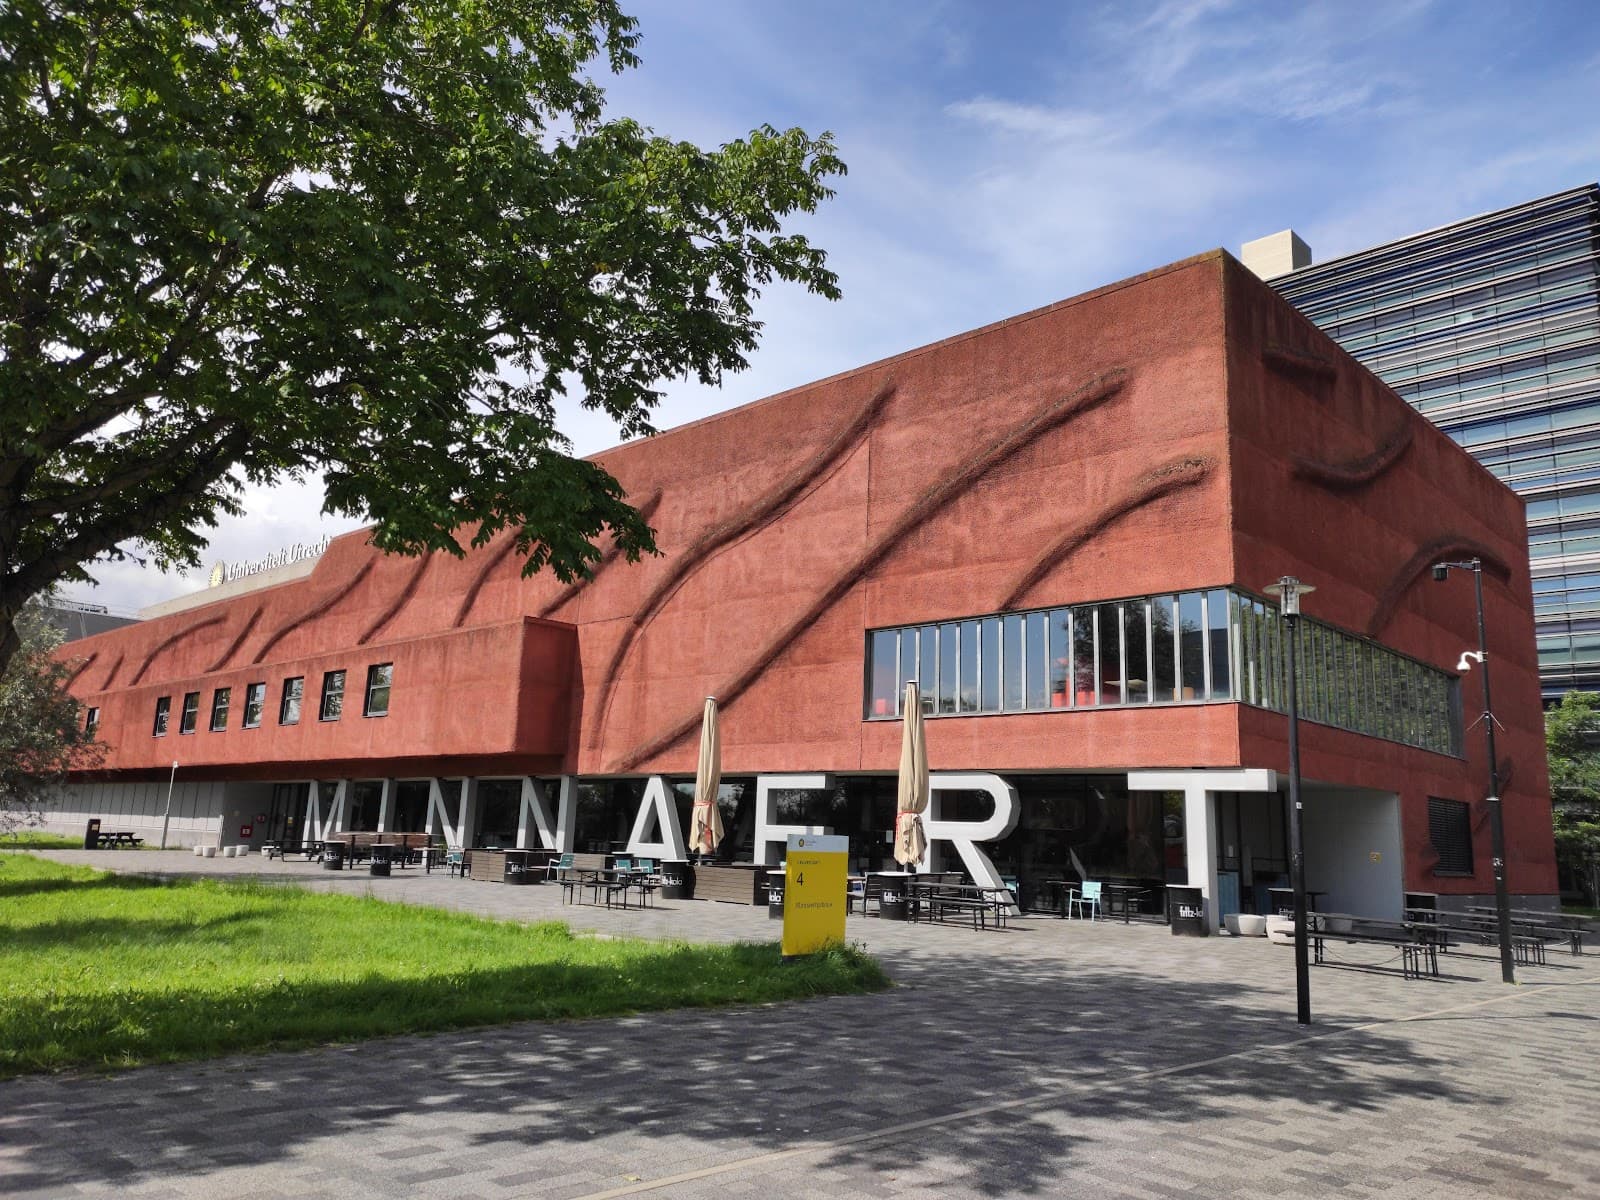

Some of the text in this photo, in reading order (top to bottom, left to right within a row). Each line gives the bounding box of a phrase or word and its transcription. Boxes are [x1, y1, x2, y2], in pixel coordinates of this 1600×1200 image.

[227, 548, 288, 581] Universiteit
[302, 768, 1277, 937] MINNAERT
[796, 871, 805, 886] 4
